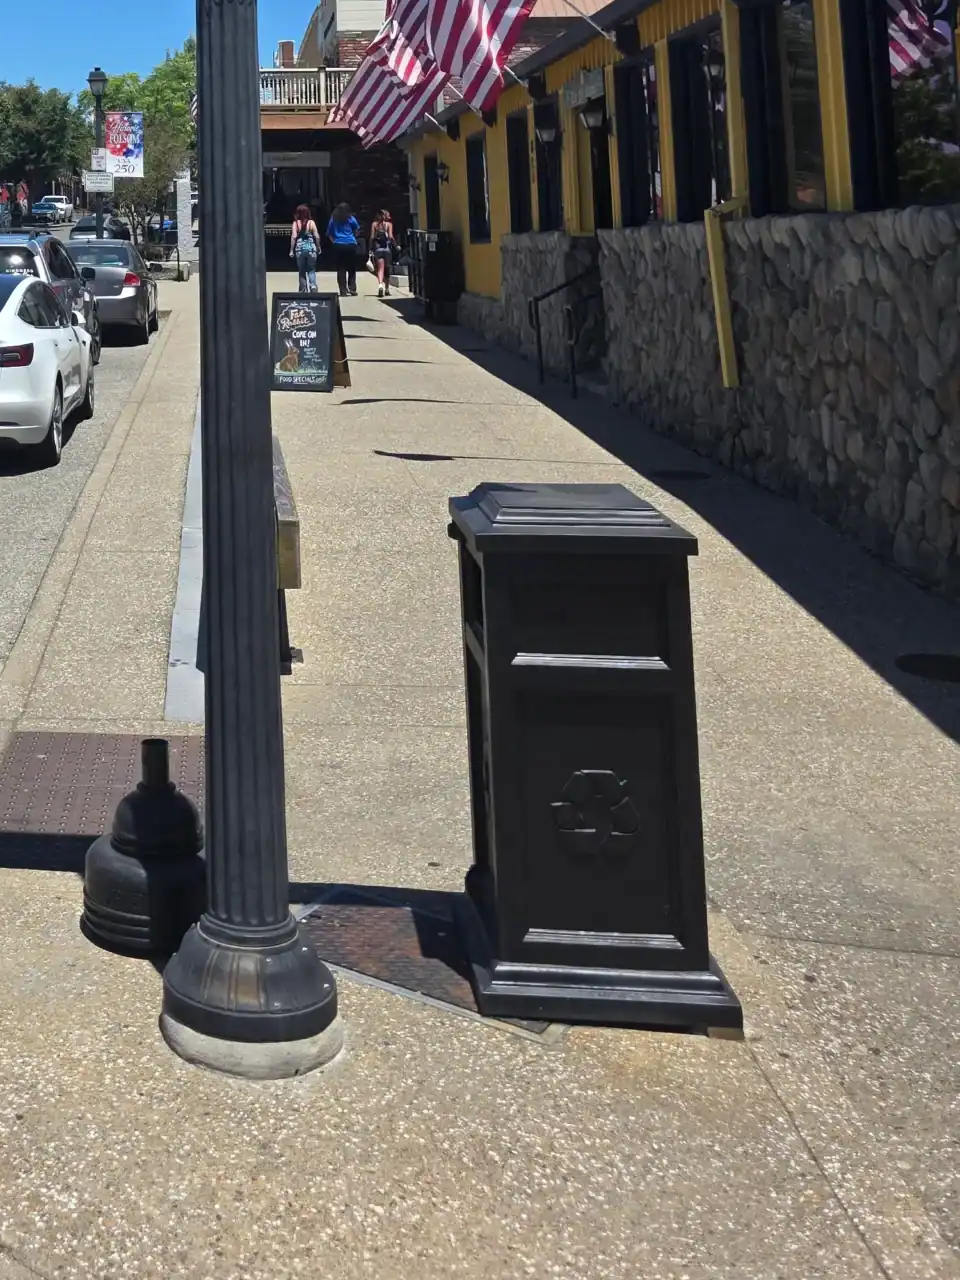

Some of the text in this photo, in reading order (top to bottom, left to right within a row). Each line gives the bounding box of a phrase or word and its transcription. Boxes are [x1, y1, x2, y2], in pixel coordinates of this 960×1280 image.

[109, 133, 140, 144] FOLSOM
[114, 164, 136, 174] 250
[290, 309, 306, 320] Fat
